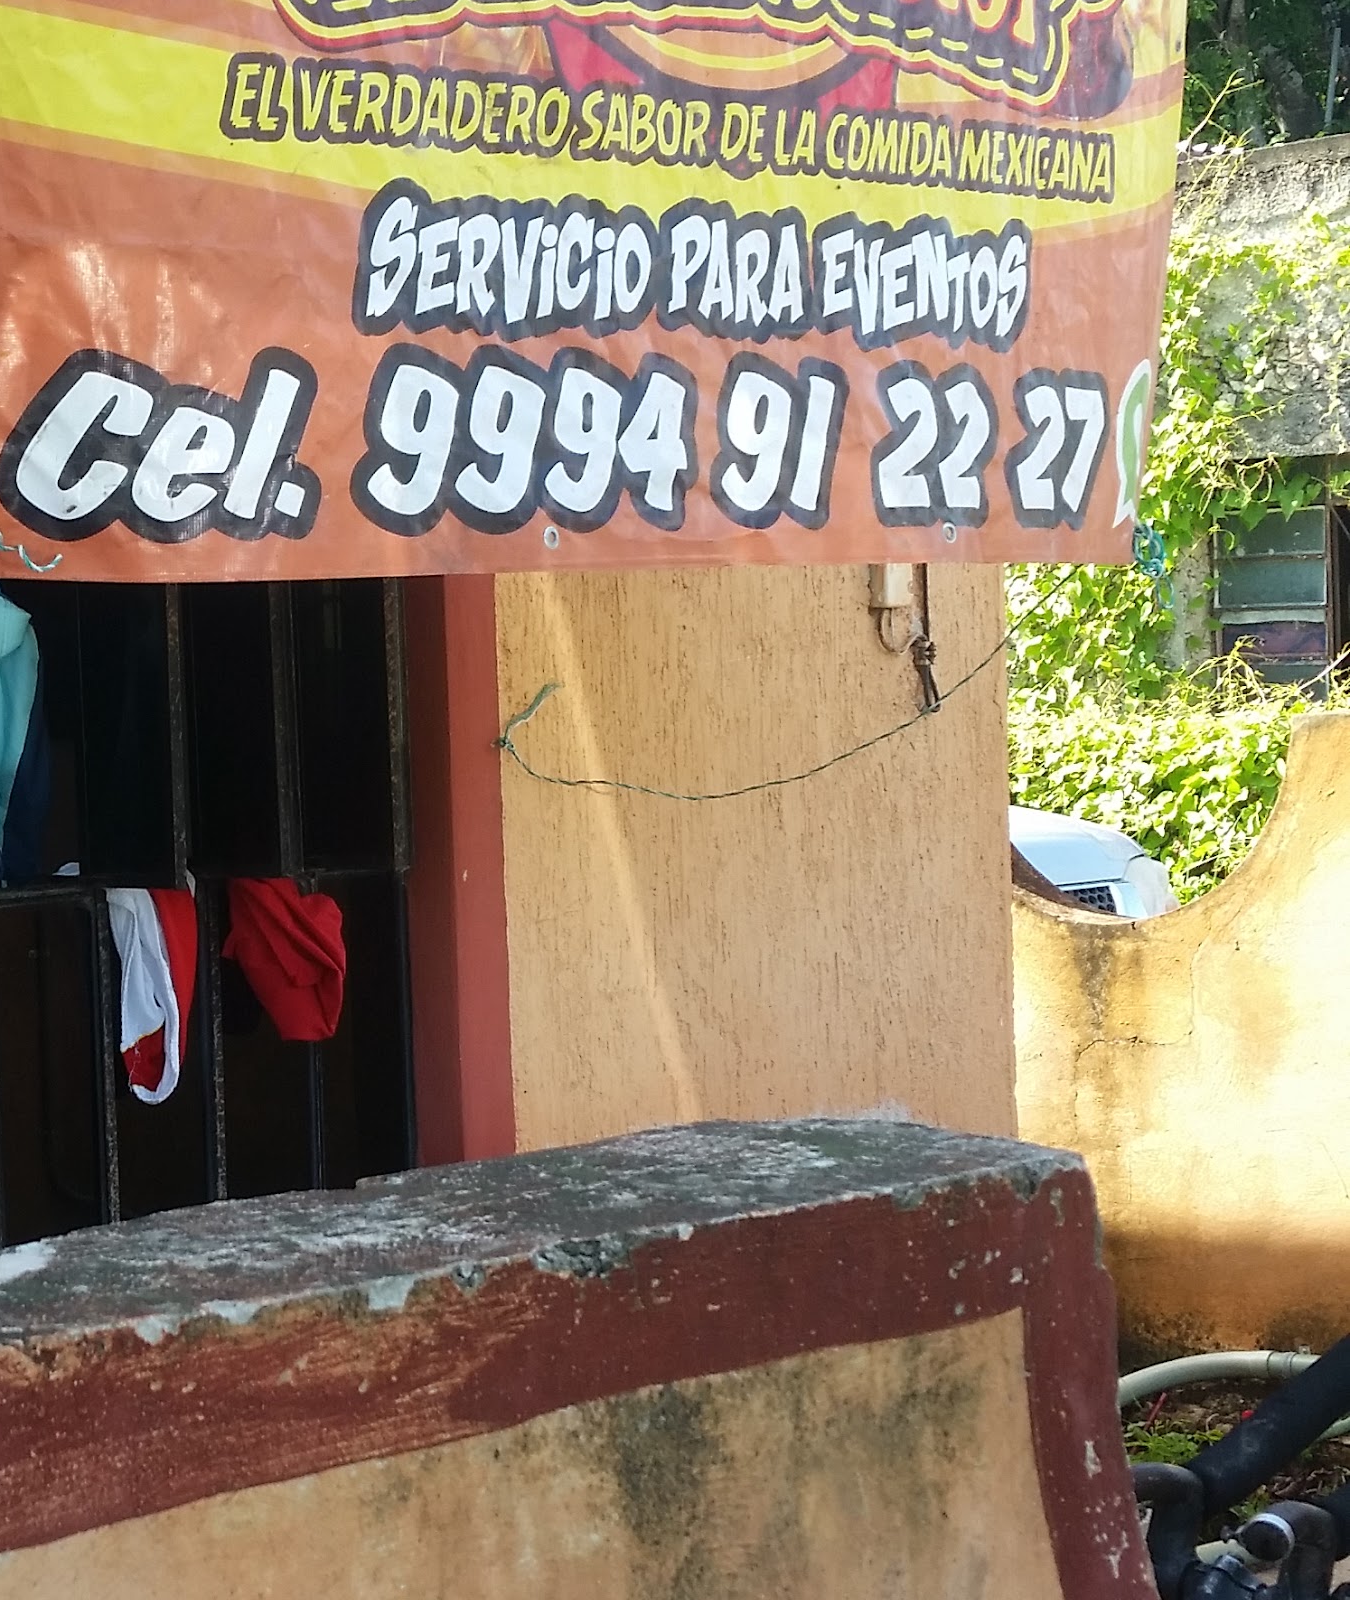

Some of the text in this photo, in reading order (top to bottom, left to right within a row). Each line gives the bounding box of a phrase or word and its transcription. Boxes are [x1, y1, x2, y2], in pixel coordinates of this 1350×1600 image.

[230, 62, 1112, 195] EL VERDADERO SABOR DE LA COMIDA MEXICANA
[667, 213, 807, 327] PARA
[821, 226, 1029, 338] EVENTOS
[11, 362, 1106, 524] Cel. 9994 91 22 27
